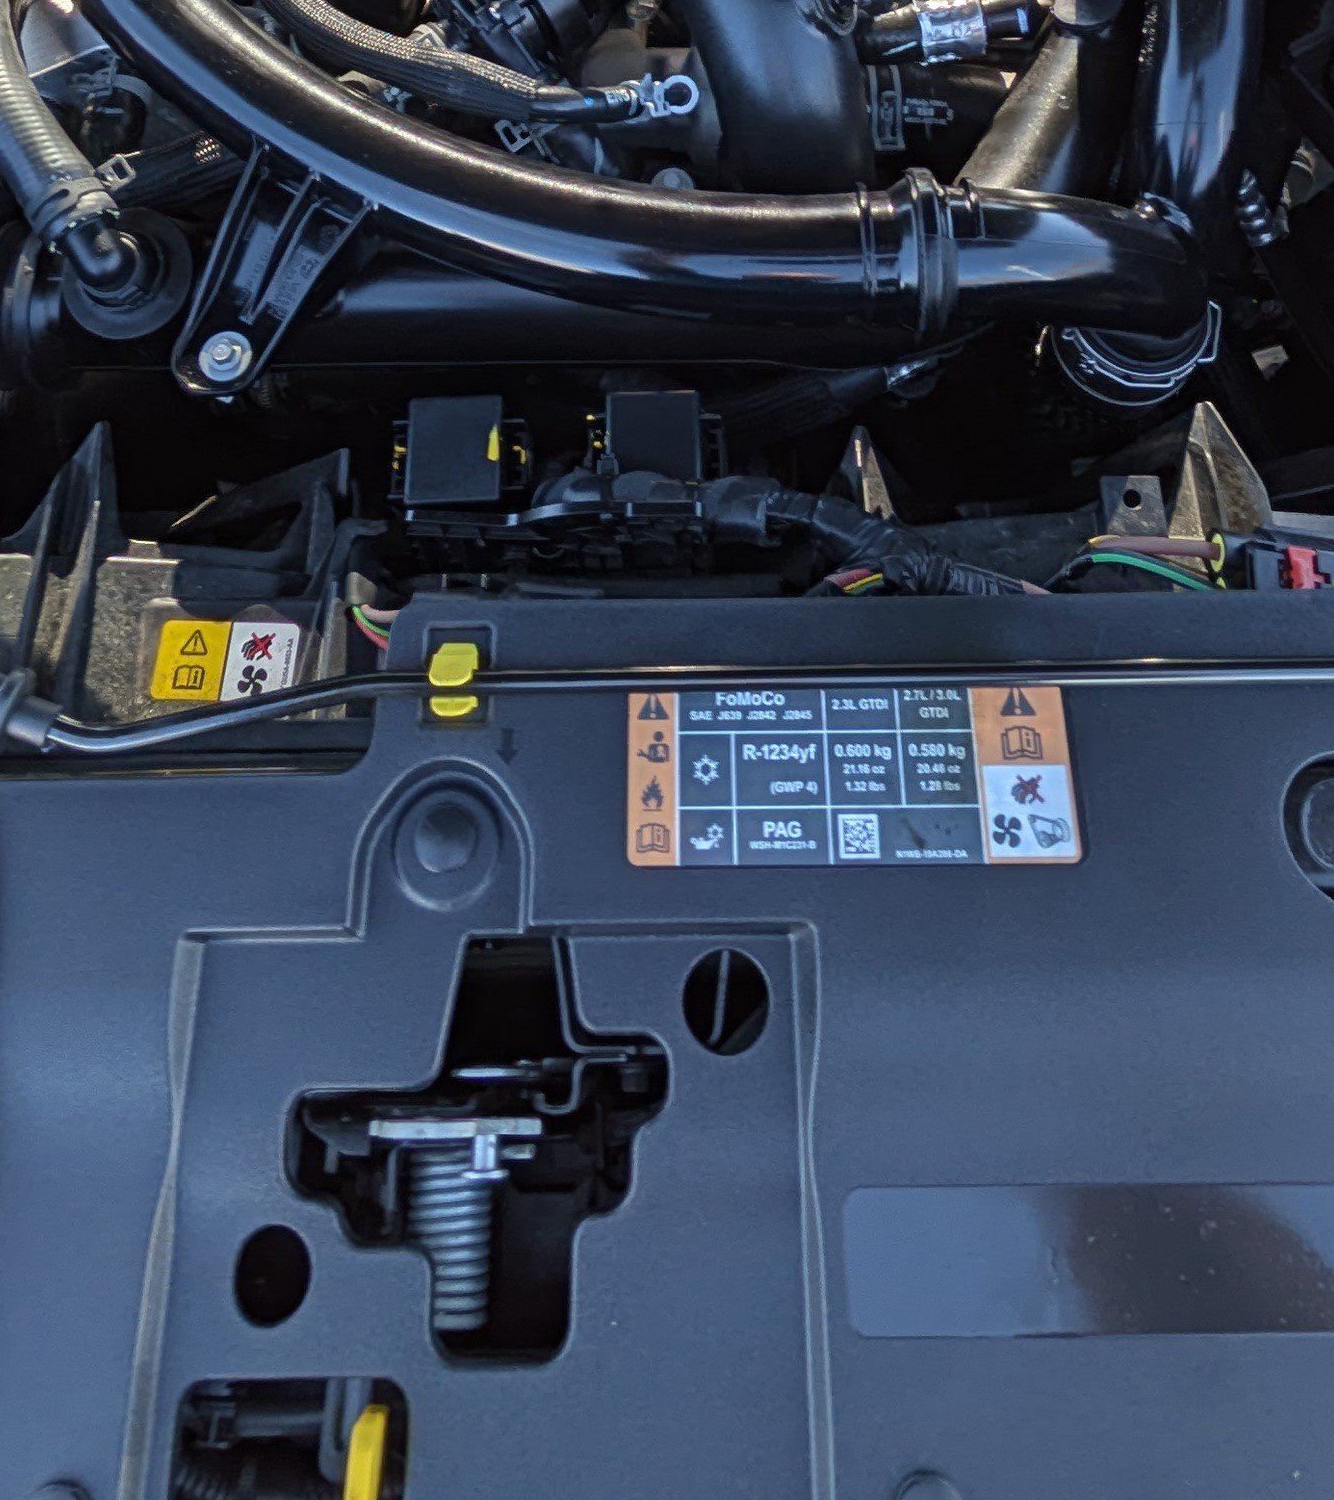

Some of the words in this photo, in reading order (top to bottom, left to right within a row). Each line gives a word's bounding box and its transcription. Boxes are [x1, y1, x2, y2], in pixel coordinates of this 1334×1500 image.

[715, 691, 785, 706] FoMoCo
[831, 698, 858, 711] 2.3L
[858, 698, 889, 711] GTDI
[689, 710, 713, 721] SAE
[917, 706, 950, 718] GTDI
[742, 743, 818, 764] R-1234yf
[833, 743, 871, 758] 0.600
[873, 743, 893, 761] kg
[908, 743, 946, 757] 0.580
[947, 743, 966, 760] kg
[871, 765, 887, 775] oz
[947, 764, 962, 774] oz
[769, 781, 805, 796] (GWP
[805, 781, 820, 796] 4)
[844, 781, 868, 792] 1.32
[868, 780, 887, 792] lbs
[942, 780, 962, 792] lbs
[762, 821, 803, 838] PAG
